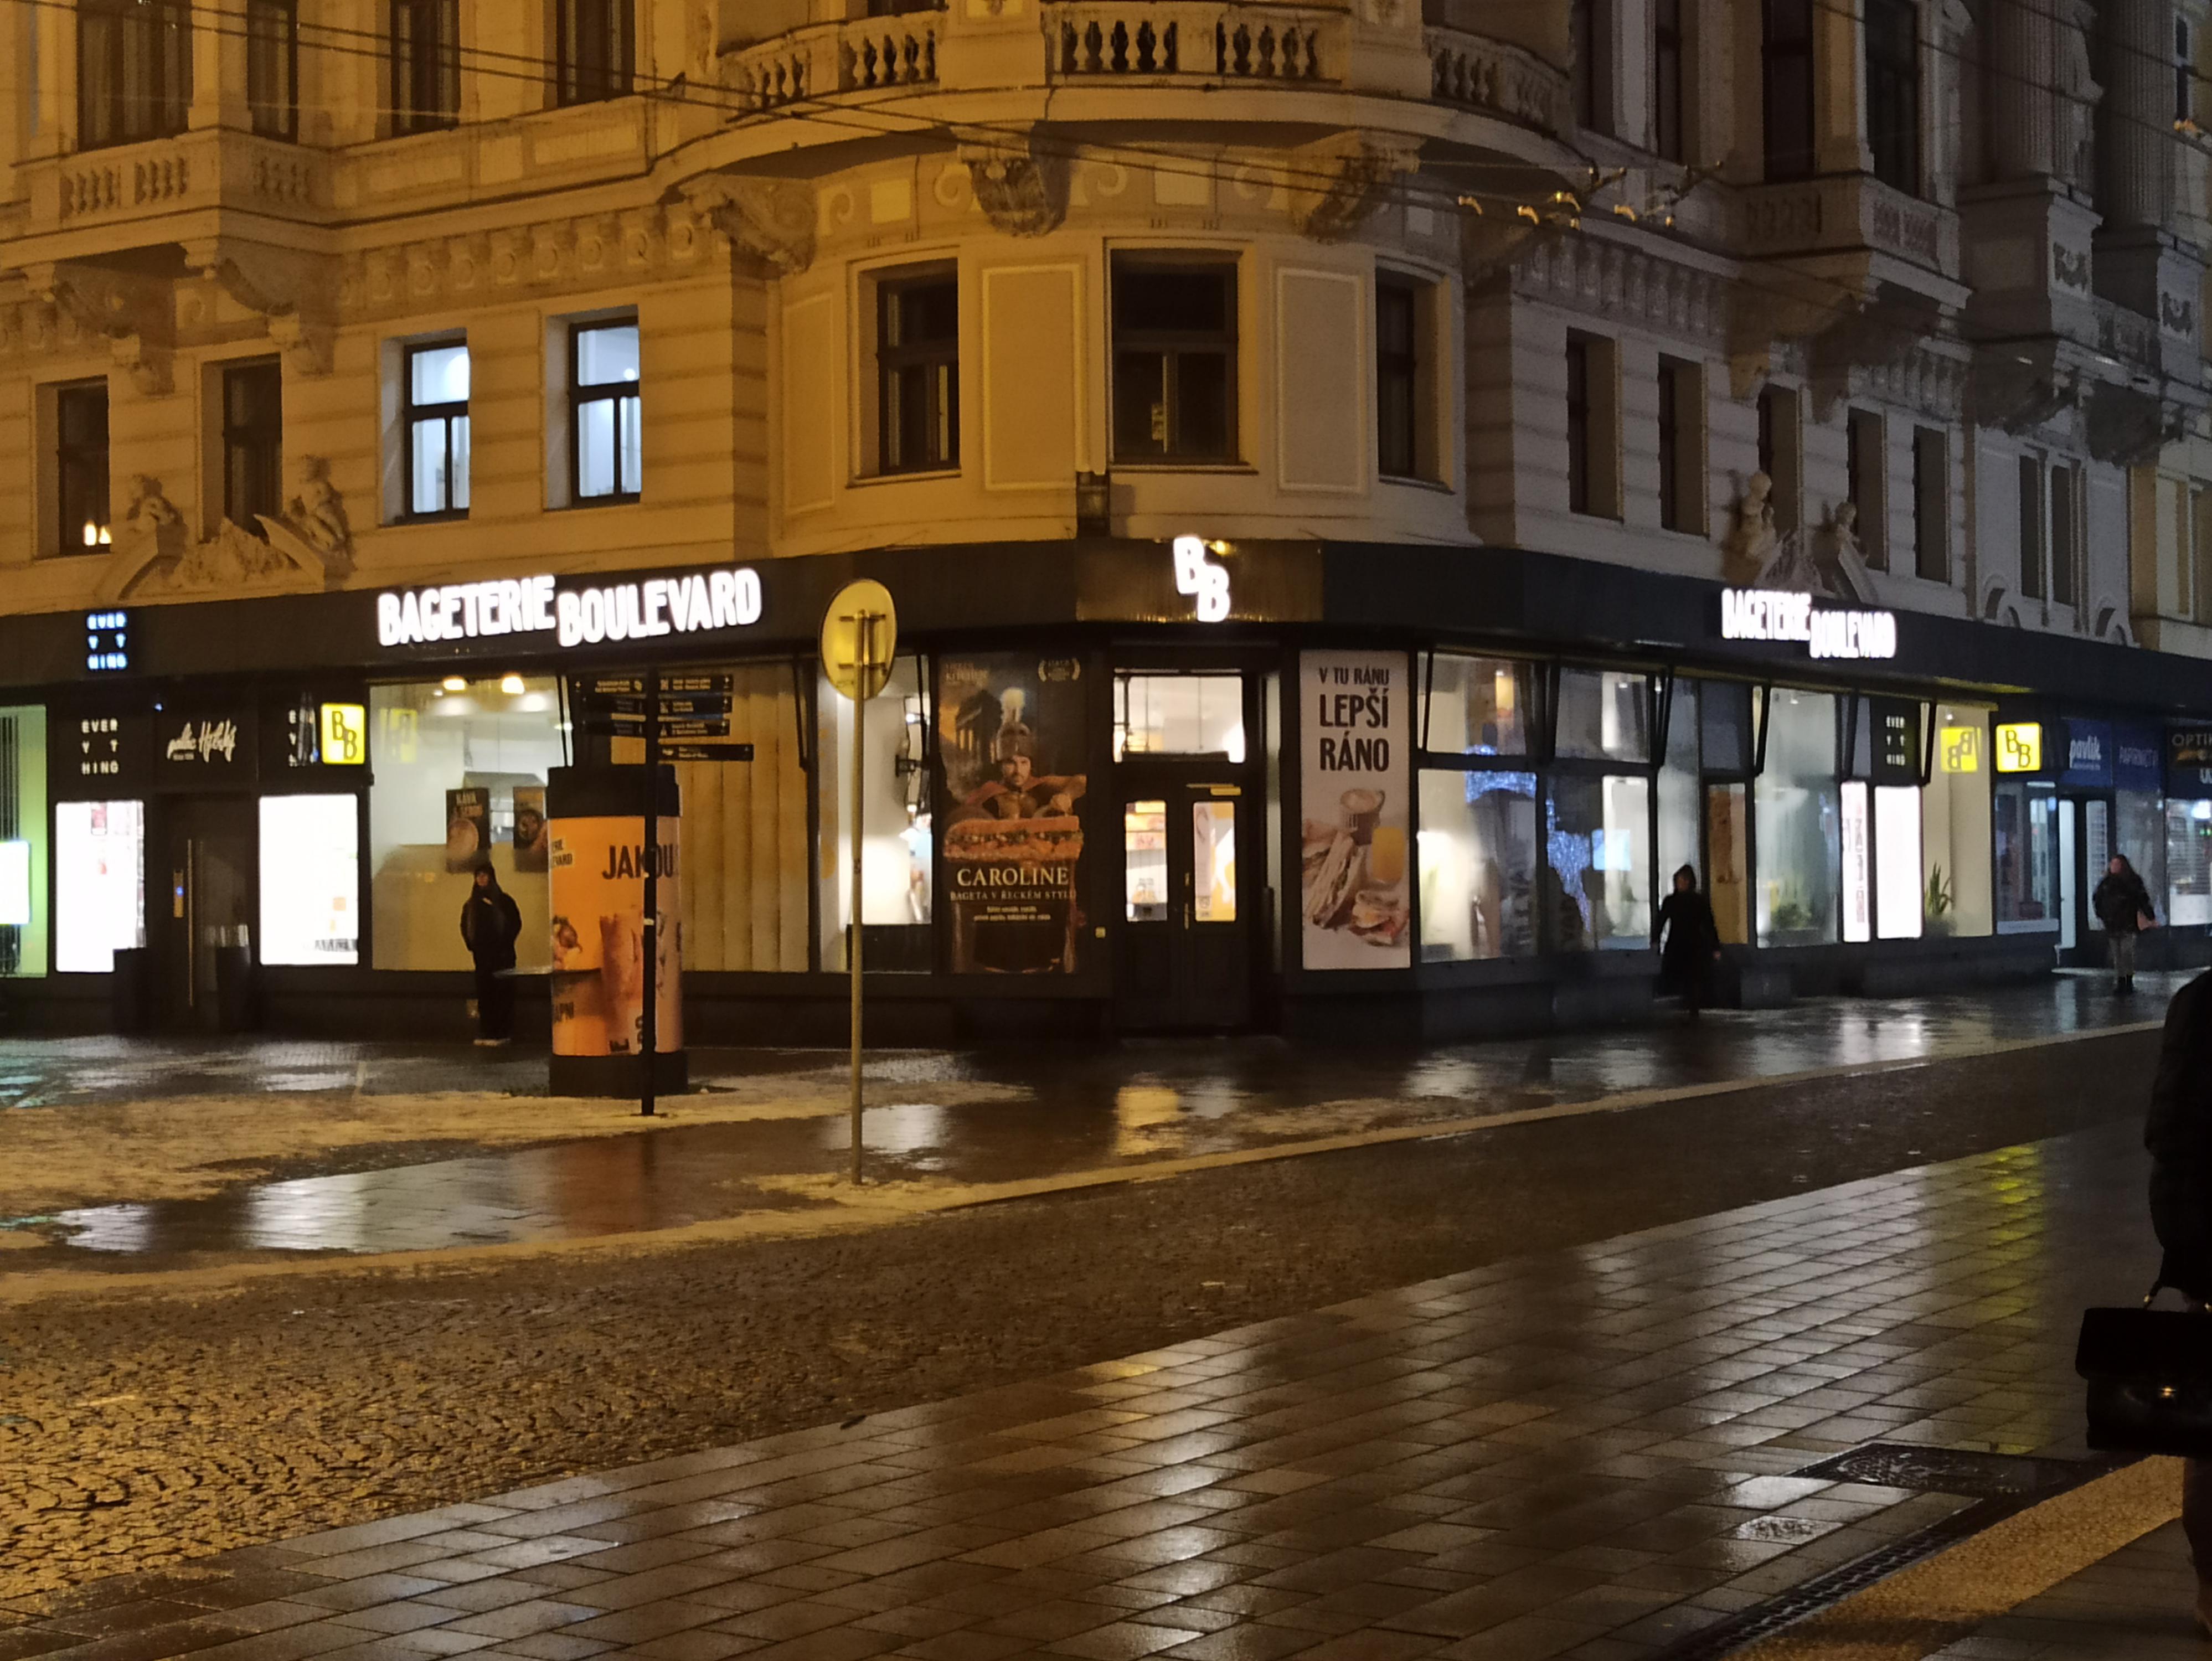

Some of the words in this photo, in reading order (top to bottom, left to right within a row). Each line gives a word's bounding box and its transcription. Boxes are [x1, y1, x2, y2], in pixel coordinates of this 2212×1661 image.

[1173, 535, 1230, 622] BB
[377, 575, 555, 646] BAGETERIE
[558, 568, 762, 647] BOULEVARD
[1722, 588, 1811, 640] BAGETERIE
[1810, 610, 1895, 658] BOULEVARD
[1319, 667, 1327, 684] V
[1334, 667, 1349, 684] TU
[1354, 666, 1389, 684] RÁNU
[81, 718, 118, 733] EVER
[1319, 688, 1389, 728] LEPŠÍ
[332, 711, 357, 760] BB
[1319, 730, 1389, 772] RÁNO
[2004, 729, 2031, 768] BB
[81, 760, 119, 775] HING
[950, 891, 988, 901] BAGETA
[1001, 890, 1041, 900] ŘECKÉM
[957, 866, 1069, 887] CAROLINE
